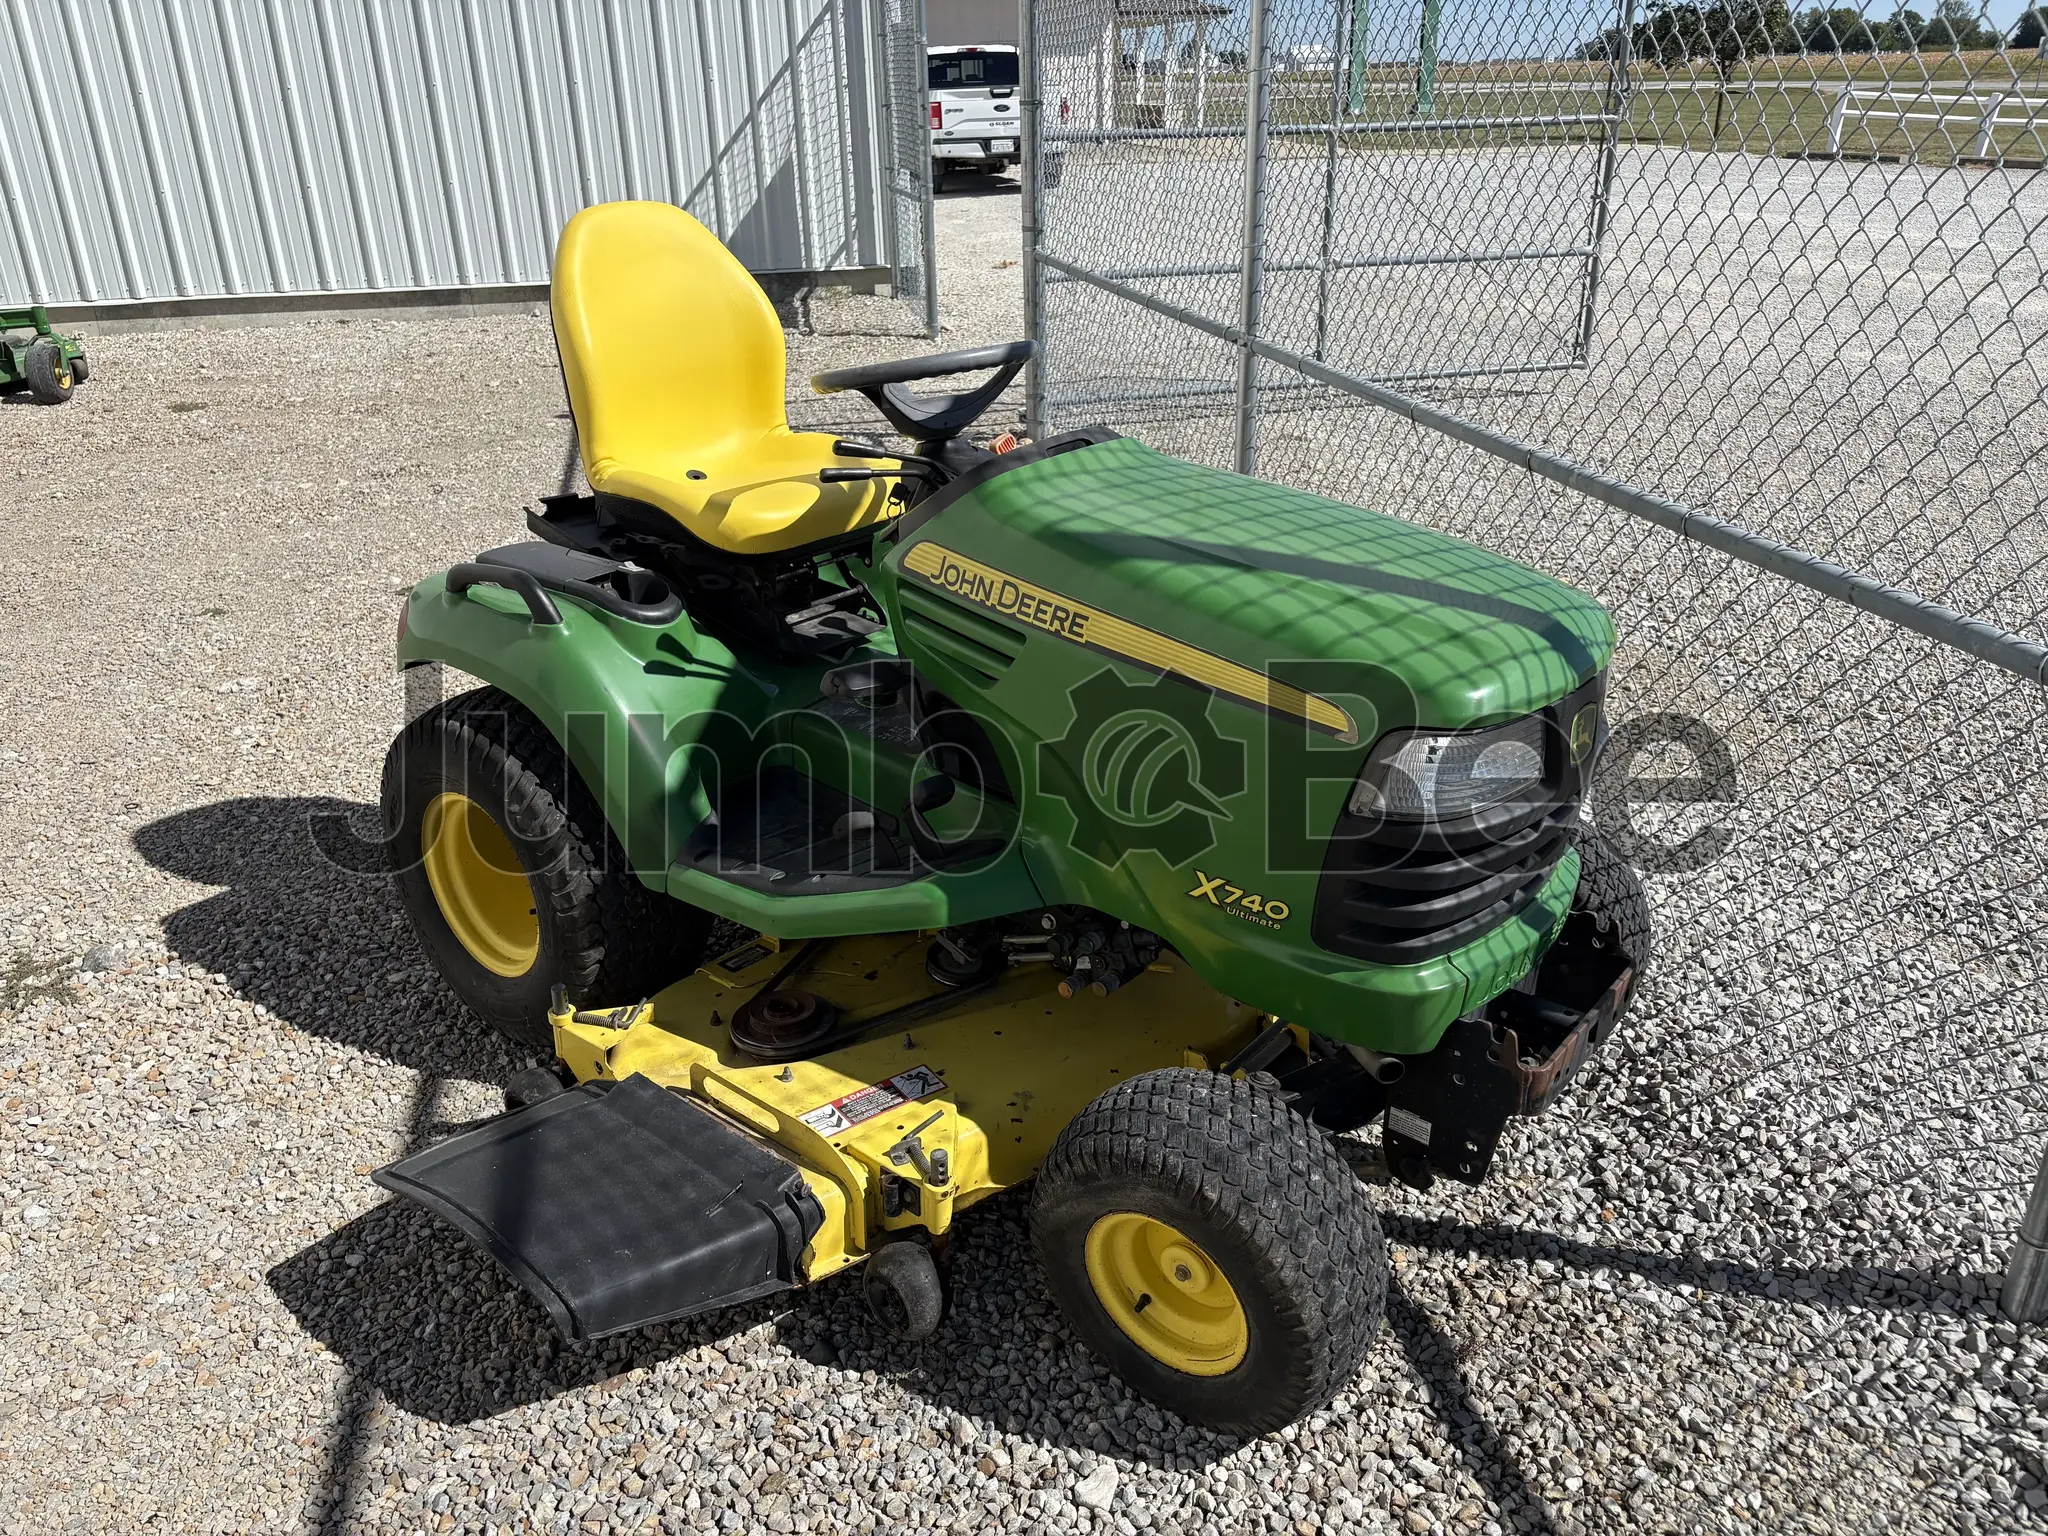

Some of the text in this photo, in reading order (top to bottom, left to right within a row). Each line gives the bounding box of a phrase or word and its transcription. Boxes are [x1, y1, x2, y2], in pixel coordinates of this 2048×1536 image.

[930, 555, 1090, 640] JOHN DEERE
[1185, 868, 1290, 920] X740
[1226, 906, 1281, 930] Ultimate
[849, 1083, 885, 1101] DANGER
